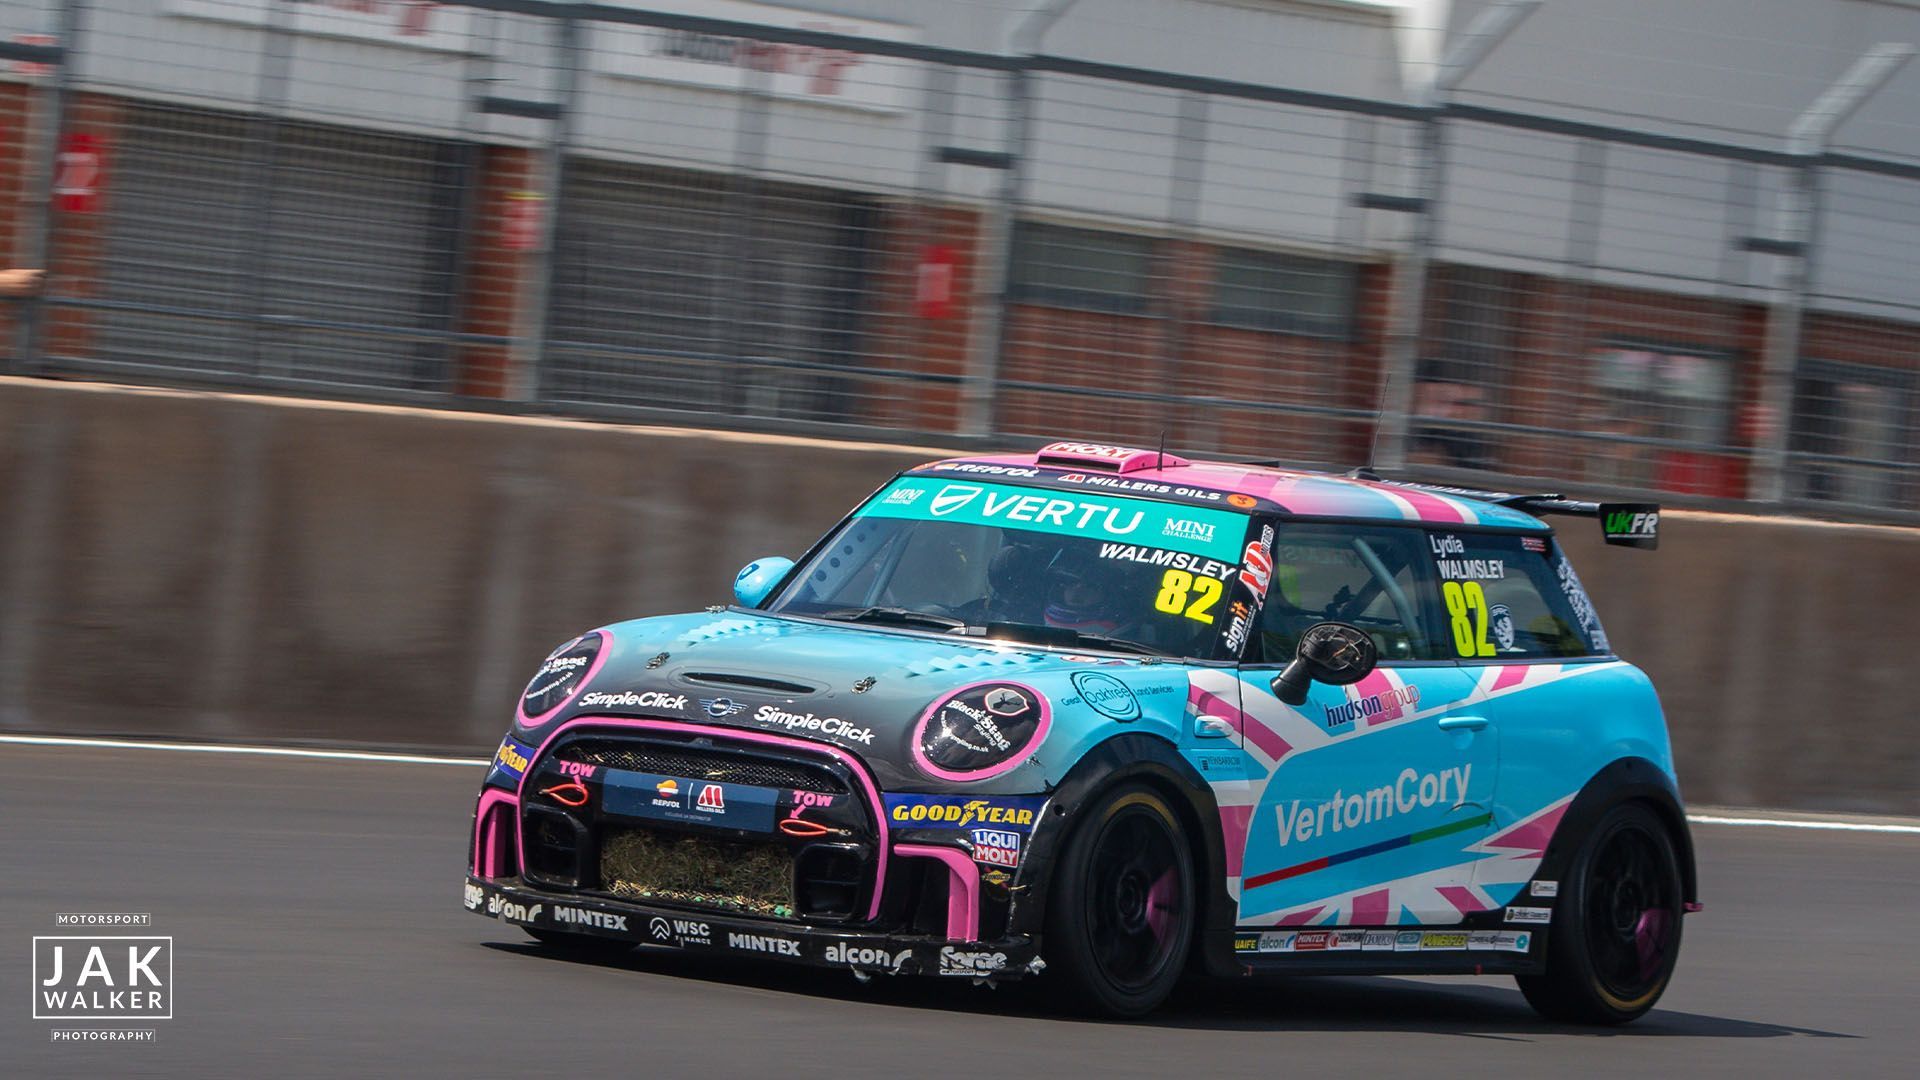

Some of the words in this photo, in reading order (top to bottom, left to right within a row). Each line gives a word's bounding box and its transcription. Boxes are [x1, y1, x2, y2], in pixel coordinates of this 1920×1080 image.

[955, 463, 1039, 478] REPSOL
[1086, 475, 1172, 494] MILLERS
[1179, 486, 1222, 501] OILS
[981, 491, 1144, 534] VERTU
[1605, 512, 1658, 534] UKFR
[1161, 529, 1214, 543] CHALLENGE
[1164, 518, 1217, 537] MINI
[1429, 535, 1465, 559] Lydia
[1099, 543, 1237, 581] WALMSLEY
[1436, 558, 1505, 580] WALMSLEY
[1155, 569, 1223, 625] 82
[1442, 581, 1497, 657] 82
[578, 691, 689, 711] SimpleClick
[1084, 686, 1131, 704] Oaktree
[753, 705, 876, 745] SimpleClick
[945, 699, 981, 722] Black
[979, 710, 1011, 752] Stag
[973, 723, 997, 747] Styling
[559, 760, 597, 778] TOW
[652, 798, 681, 809] REPSOL
[793, 789, 834, 807] TOW
[1275, 763, 1472, 848] VertomCory
[974, 831, 1017, 848] LIQUI
[975, 846, 1018, 865] MOLY
[553, 905, 629, 931] MINTEX
[673, 919, 711, 937] WSC
[728, 932, 801, 957] MINTEX
[1234, 939, 1257, 950] UAIFE
[1260, 935, 1285, 949] alcon
[825, 942, 892, 967] alcon
